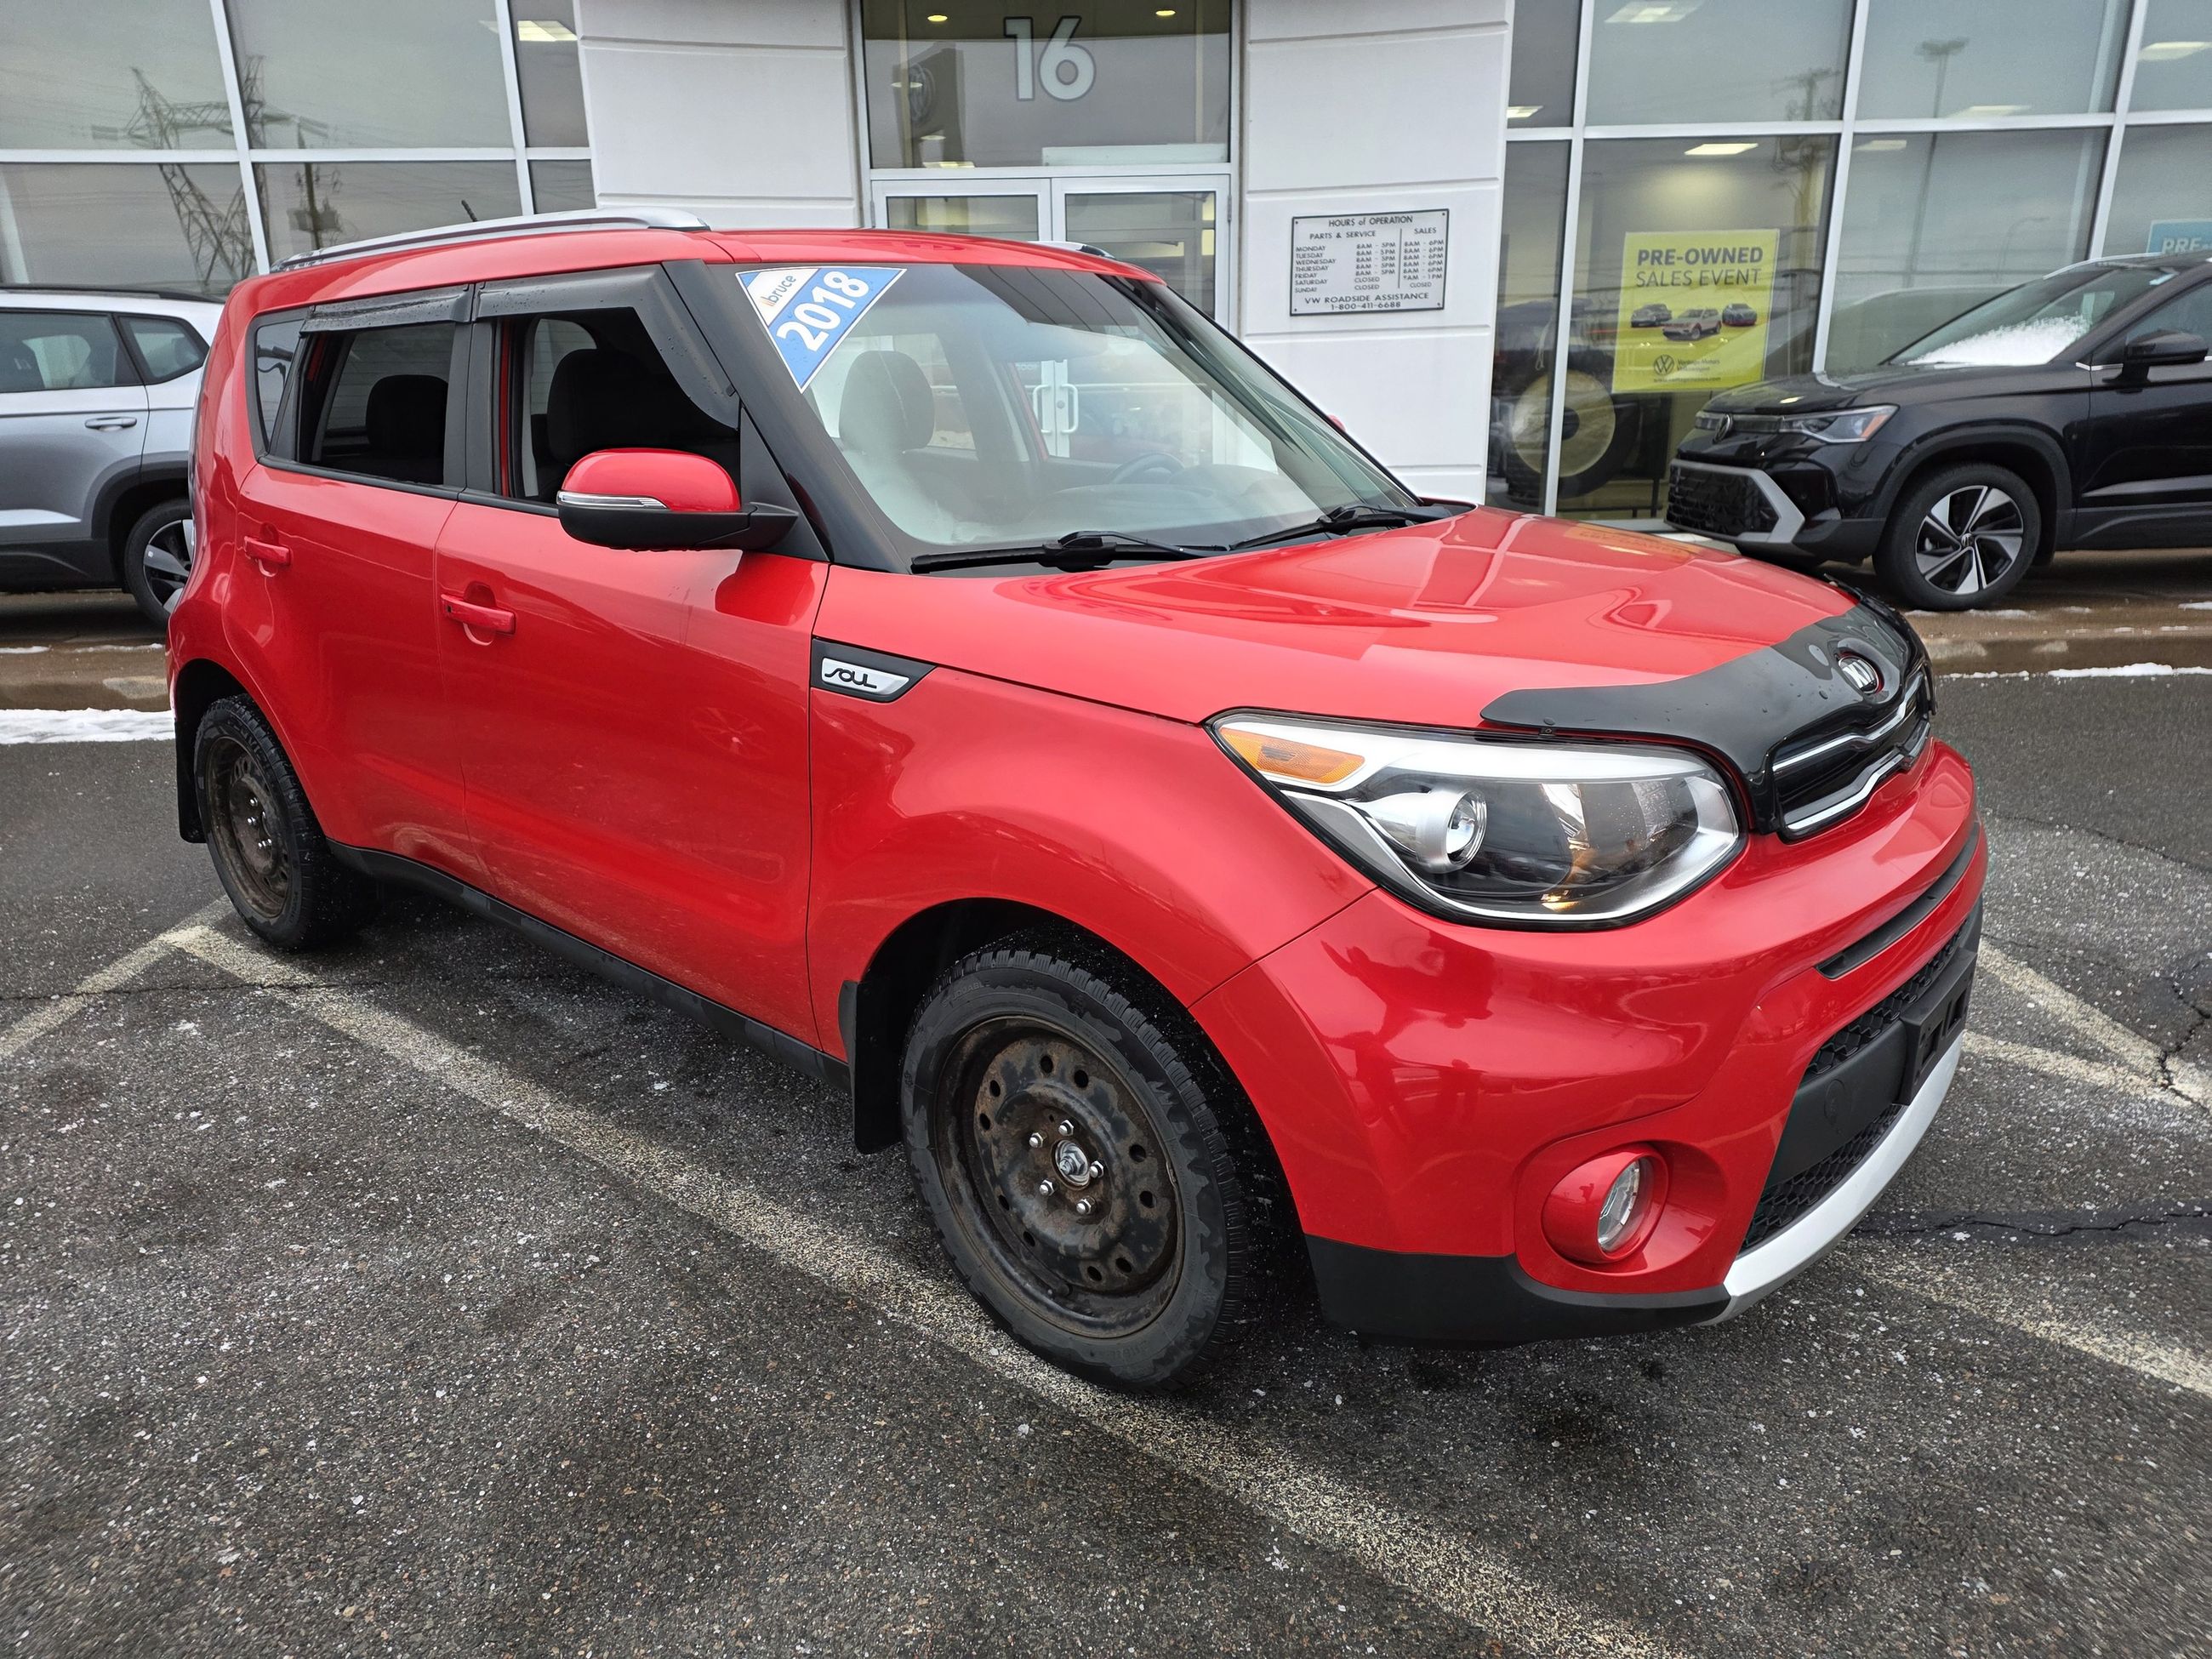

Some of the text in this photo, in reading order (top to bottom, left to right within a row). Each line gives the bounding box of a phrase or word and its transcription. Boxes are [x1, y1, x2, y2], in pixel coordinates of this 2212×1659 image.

[1003, 15, 1097, 102] 16
[1328, 219, 1355, 227] HOURS
[1369, 215, 1413, 225] OPERATION
[1637, 247, 1764, 266] PRE-OWNED
[1636, 268, 1762, 288] SALES EVENT
[1325, 295, 1371, 304] ROADSIDE
[1375, 293, 1429, 301] ASSISTANCE
[1331, 302, 1401, 311] 1-800-411-6688
[776, 271, 869, 351] 2018
